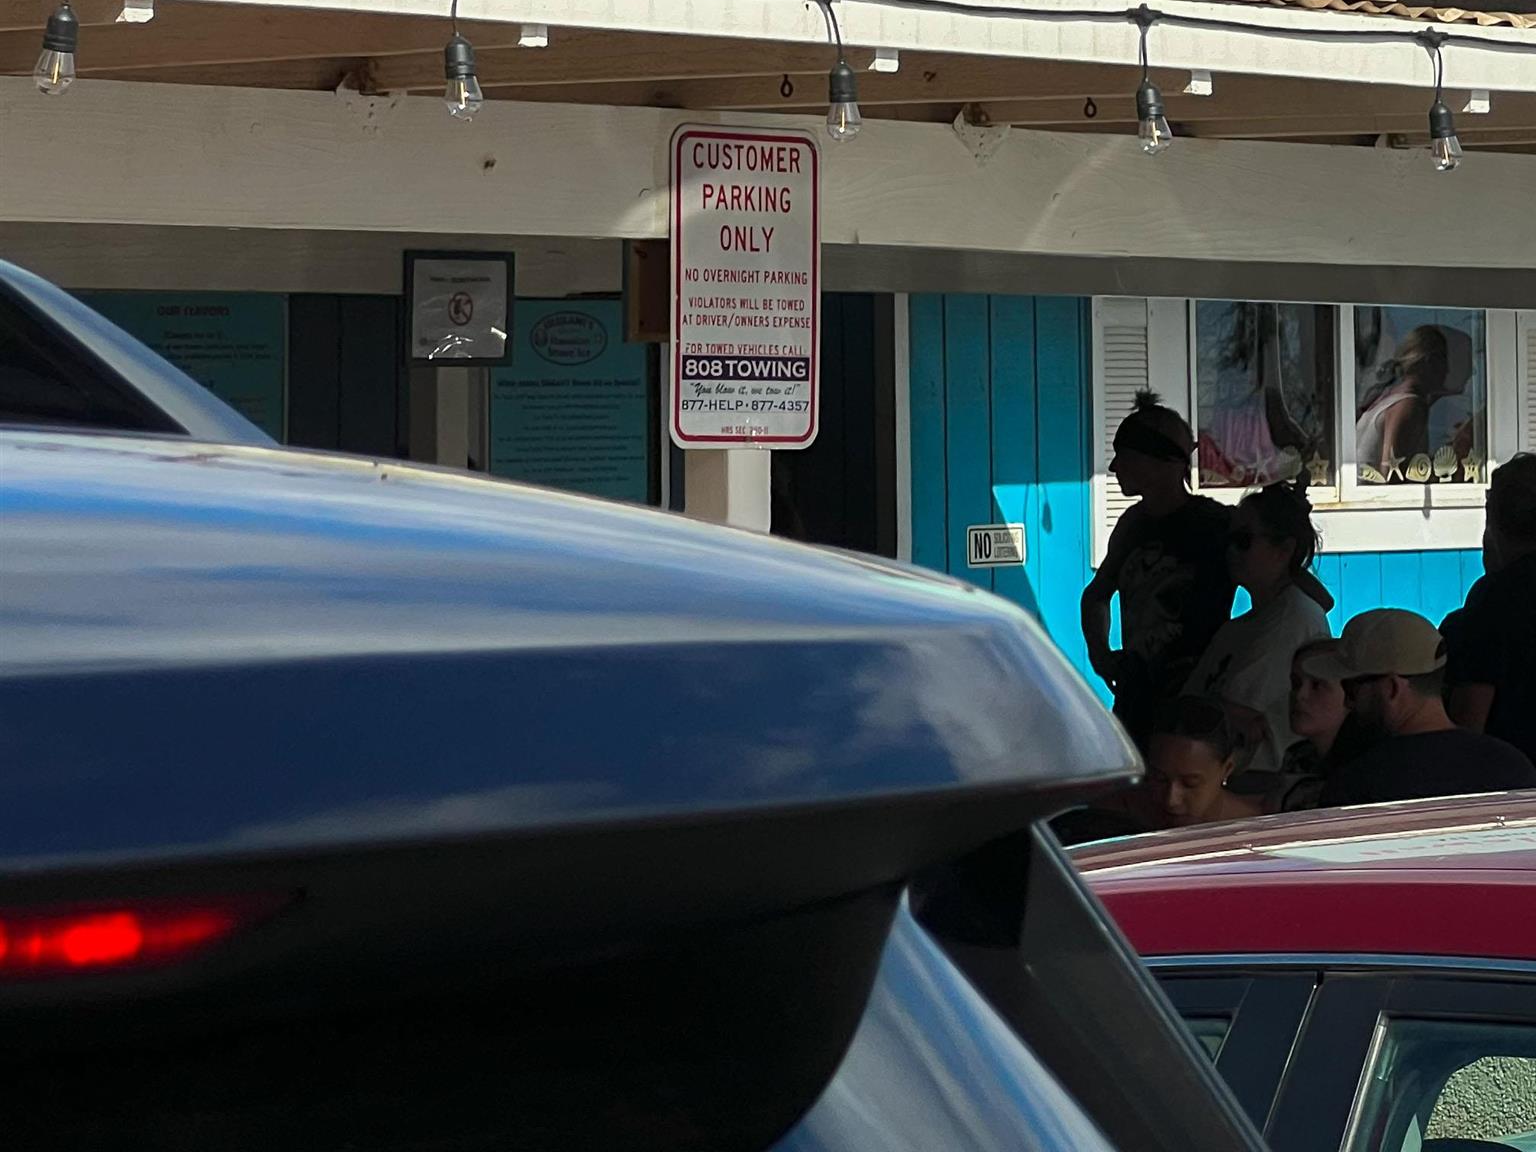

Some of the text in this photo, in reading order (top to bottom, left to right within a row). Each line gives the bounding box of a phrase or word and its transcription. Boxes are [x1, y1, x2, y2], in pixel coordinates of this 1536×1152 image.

[693, 142, 800, 173] CUSTOMER
[702, 184, 791, 213] PARKING
[720, 225, 774, 253] ONLY
[685, 268, 808, 285] NO OVERNIGHT PARKING
[689, 297, 805, 311] VIOLATORS WILL BE TOWED
[682, 313, 810, 328] AT DRIVER/OWNERS EXPENSE
[685, 343, 702, 354] FOR
[706, 344, 734, 355] TOWED
[738, 344, 779, 355] VEHICLES
[685, 359, 806, 377] 808 TOWING
[751, 400, 809, 411] 877-4357
[974, 533, 992, 559] NO
